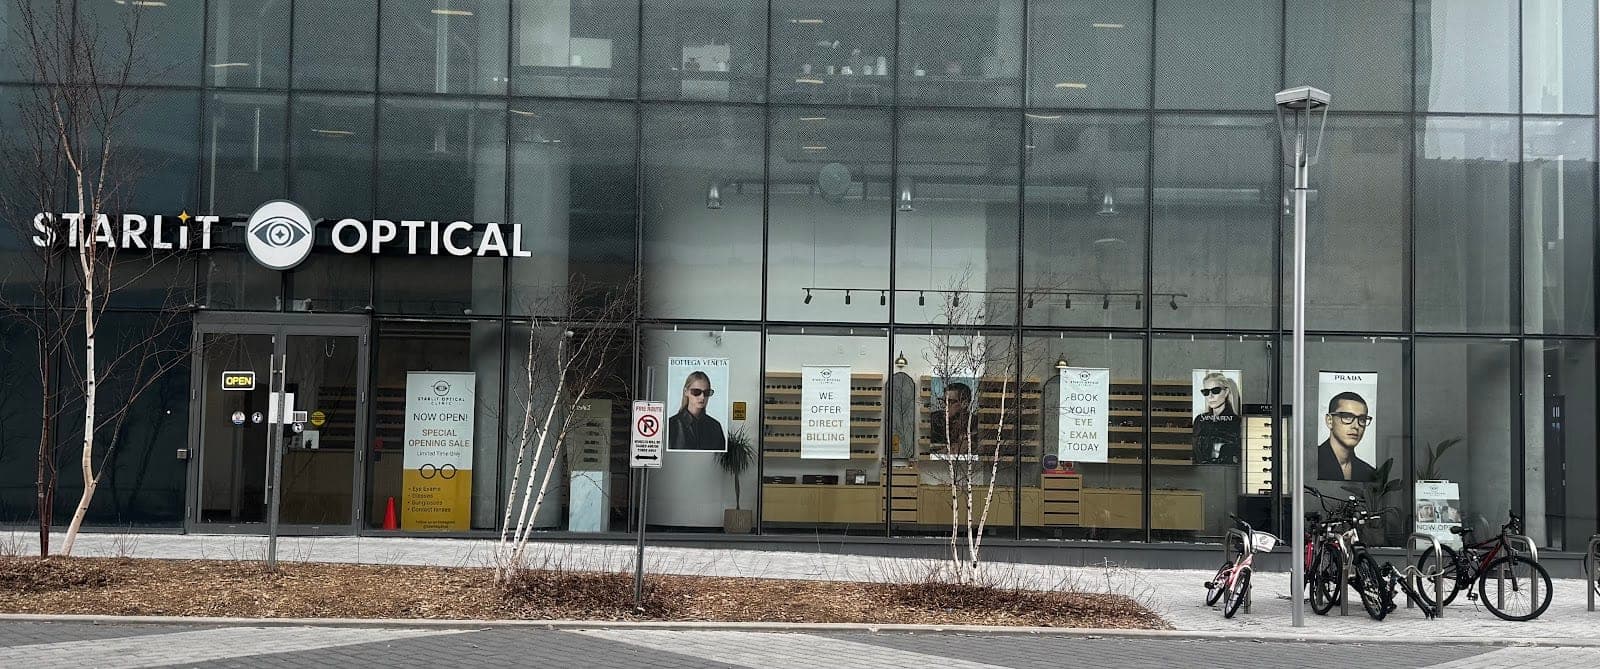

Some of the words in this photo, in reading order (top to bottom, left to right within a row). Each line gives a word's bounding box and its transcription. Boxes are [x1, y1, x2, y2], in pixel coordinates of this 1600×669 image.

[331, 218, 532, 257] OPTICAL
[225, 376, 252, 386] OPEN
[819, 392, 834, 400] WE
[1070, 393, 1098, 402] BOOK
[811, 405, 841, 414] OFFER
[1069, 406, 1096, 415] YOUR
[413, 413, 437, 421] NOW
[439, 413, 468, 422] OPEN!
[808, 419, 844, 428] DIRECT
[1075, 418, 1093, 427] EYE
[422, 429, 457, 437] SPECIAL
[806, 433, 845, 442] BILLING
[1070, 431, 1097, 440] EXAM
[408, 439, 447, 447] OPENING
[448, 439, 471, 448] SALE
[1067, 442, 1099, 452] TODAY
